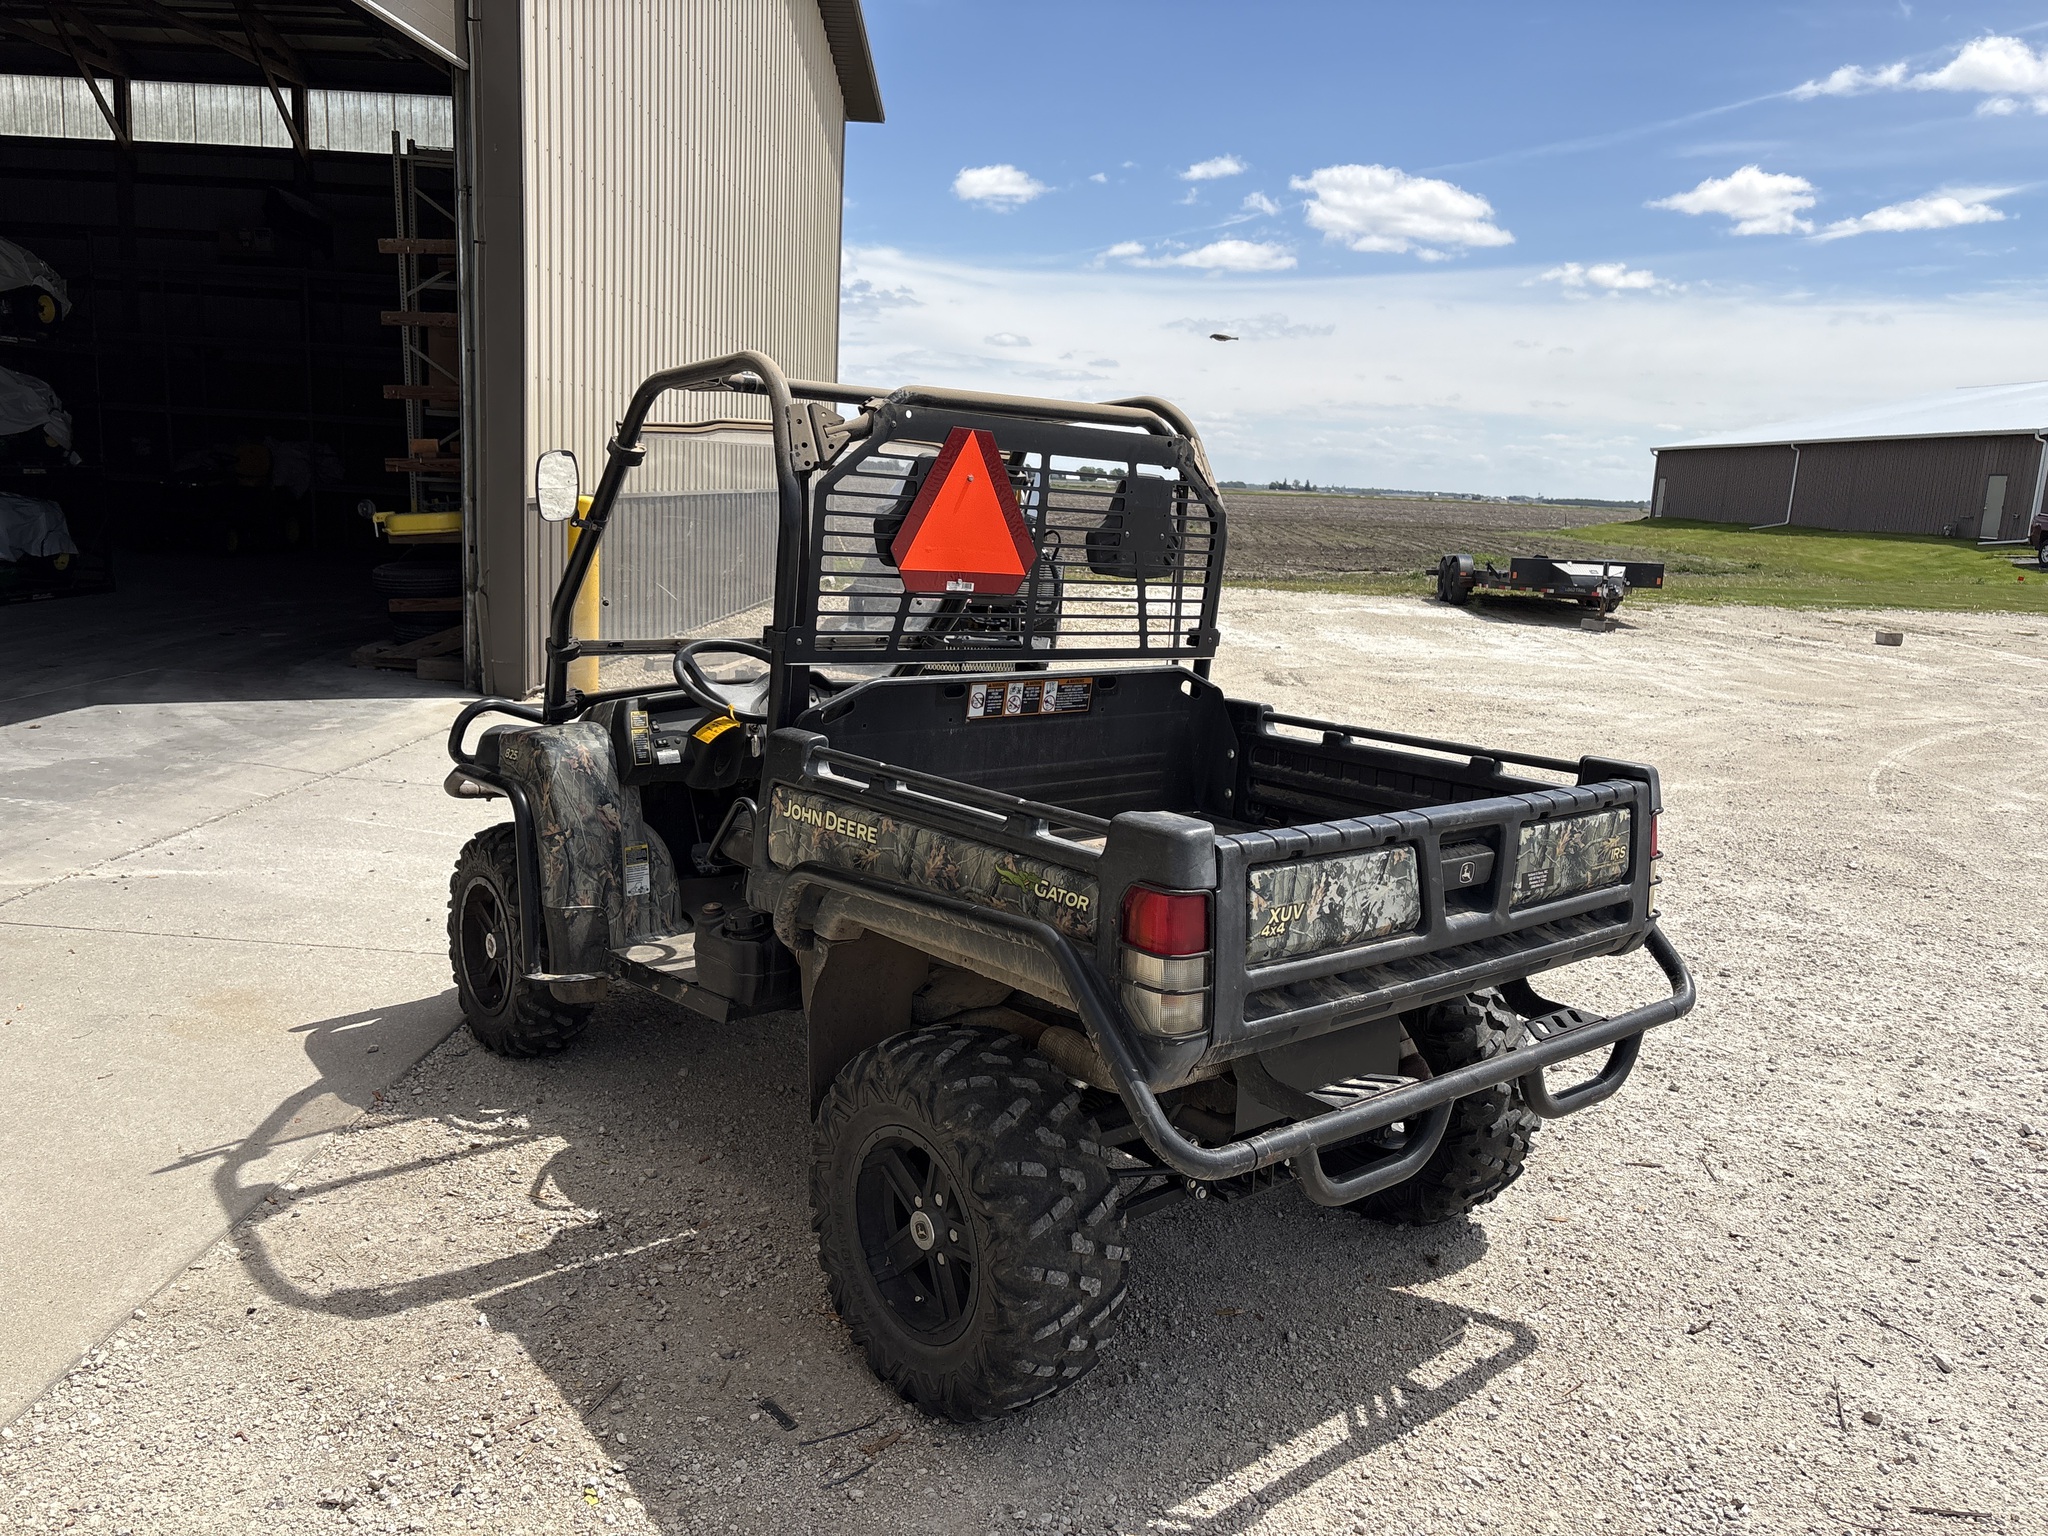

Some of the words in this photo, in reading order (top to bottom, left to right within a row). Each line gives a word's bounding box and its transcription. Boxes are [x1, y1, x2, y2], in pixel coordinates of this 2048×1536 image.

[505, 748, 518, 760] 825
[783, 799, 823, 827] JOHN
[825, 810, 878, 844] DEERE
[1033, 880, 1090, 912] GATOR
[1268, 903, 1305, 924] XUV
[1261, 922, 1285, 937] 4x4
